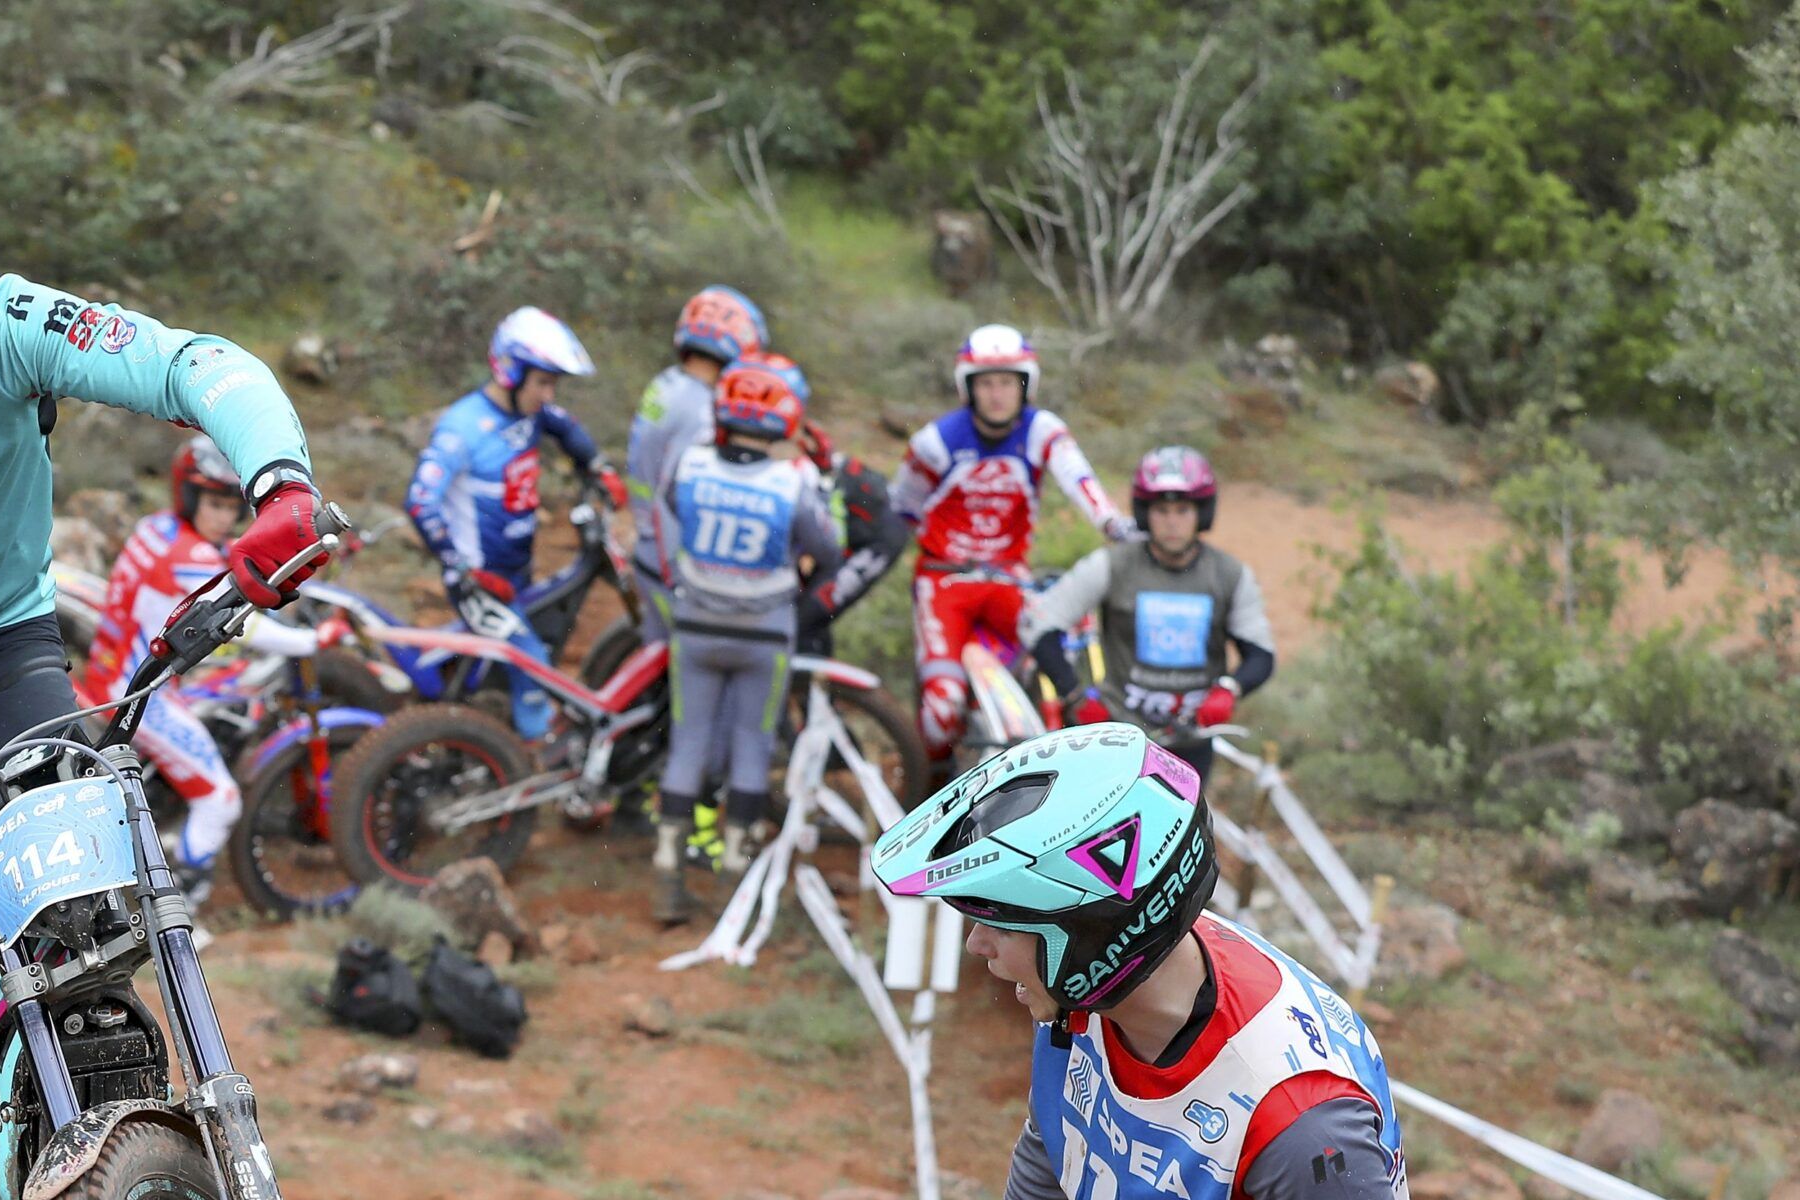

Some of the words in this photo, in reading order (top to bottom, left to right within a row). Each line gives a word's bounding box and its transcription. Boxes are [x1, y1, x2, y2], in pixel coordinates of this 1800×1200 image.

[694, 509, 770, 564] 113
[4, 829, 86, 893] 114
[926, 850, 1000, 885] hebo
[1149, 817, 1183, 868] hebo
